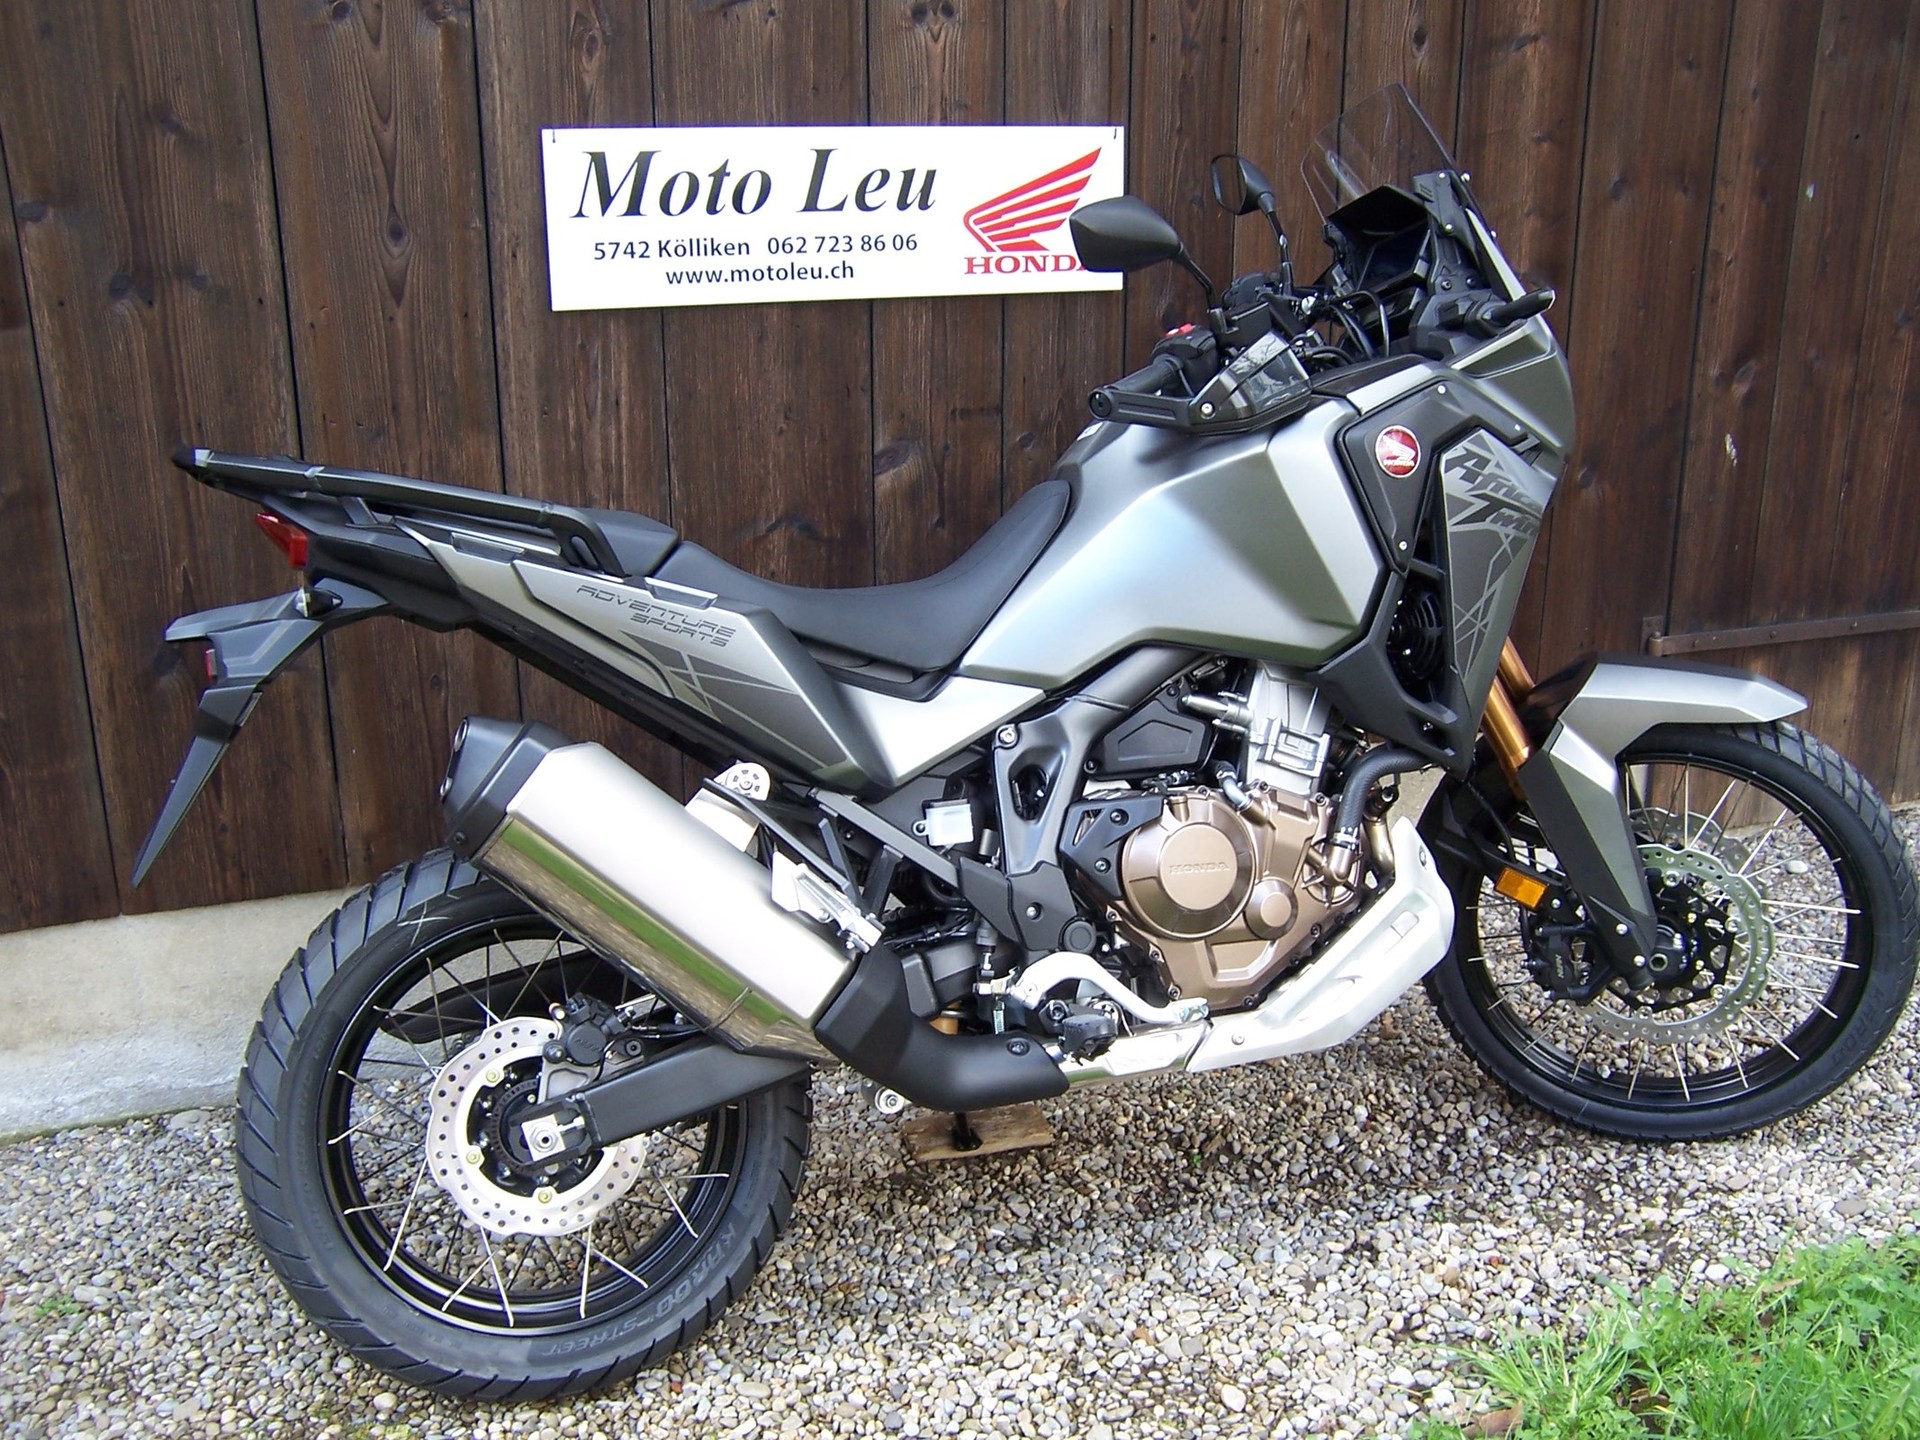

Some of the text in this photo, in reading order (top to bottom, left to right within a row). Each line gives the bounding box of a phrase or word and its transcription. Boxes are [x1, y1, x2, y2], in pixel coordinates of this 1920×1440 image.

[569, 148, 937, 218] Moto Leu
[594, 233, 918, 260] 5742 Kölliken 062 723 86 06
[666, 260, 854, 284] www.motoleu.ch
[964, 254, 1086, 274] HOND
[576, 585, 736, 638] ADVENTURE
[630, 613, 729, 647] SPORTS
[1168, 861, 1230, 876] HONDA
